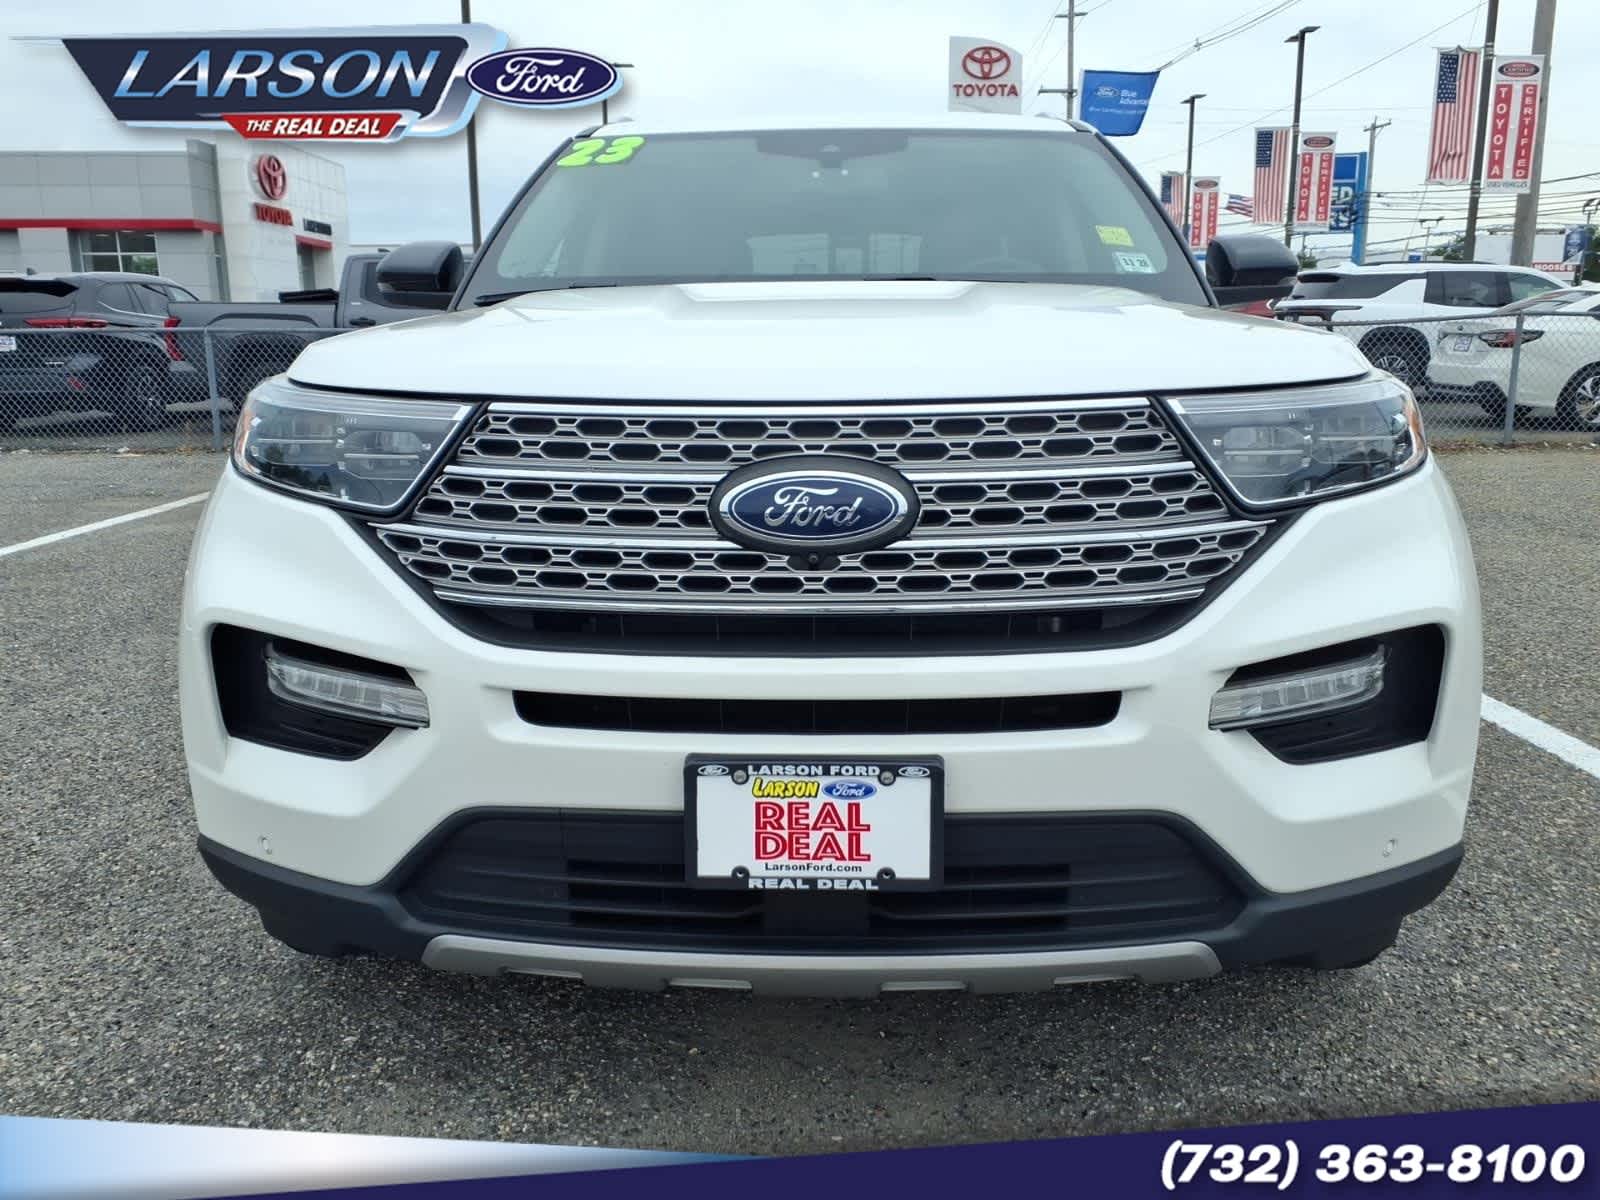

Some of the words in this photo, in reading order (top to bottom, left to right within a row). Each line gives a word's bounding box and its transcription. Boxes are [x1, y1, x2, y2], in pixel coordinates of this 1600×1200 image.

[953, 84, 1019, 97] TOYOTA
[1490, 87, 1509, 176] TOYOTA
[1515, 86, 1535, 177] CERTIFIED
[556, 136, 645, 167] 23
[1298, 154, 1311, 219] TOYOTA
[254, 203, 293, 226] TOYOTA
[764, 486, 863, 526] Ford
[748, 765, 823, 776] LARSON
[830, 765, 880, 776] FORD
[832, 783, 865, 797] Ford
[754, 801, 871, 831] REAL
[754, 832, 871, 861] DEAL
[765, 862, 863, 872] LarsonFord.com
[748, 878, 810, 889] REAL
[817, 879, 879, 890] DEAL
